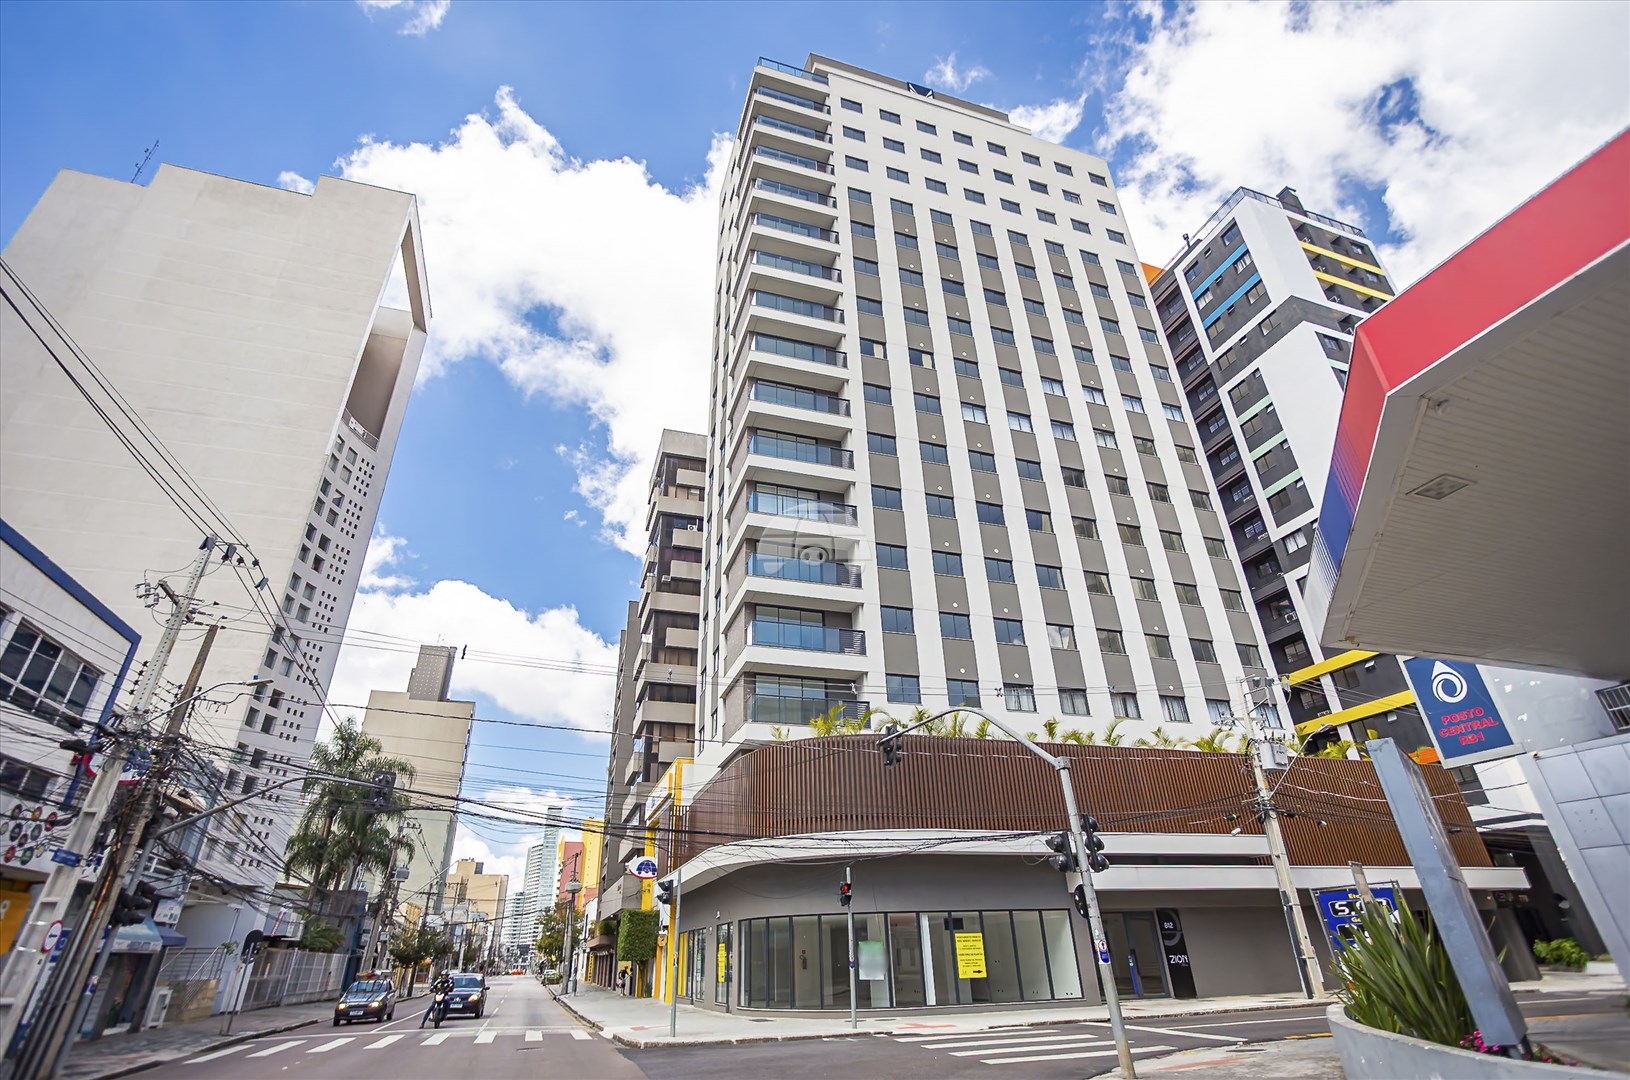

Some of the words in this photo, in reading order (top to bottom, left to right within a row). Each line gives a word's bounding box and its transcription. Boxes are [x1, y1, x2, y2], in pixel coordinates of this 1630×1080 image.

[1441, 707, 1484, 725] POSTO
[1439, 717, 1498, 737] CENTRAL
[1459, 732, 1484, 745] RB1
[1169, 955, 1188, 963] ZION
